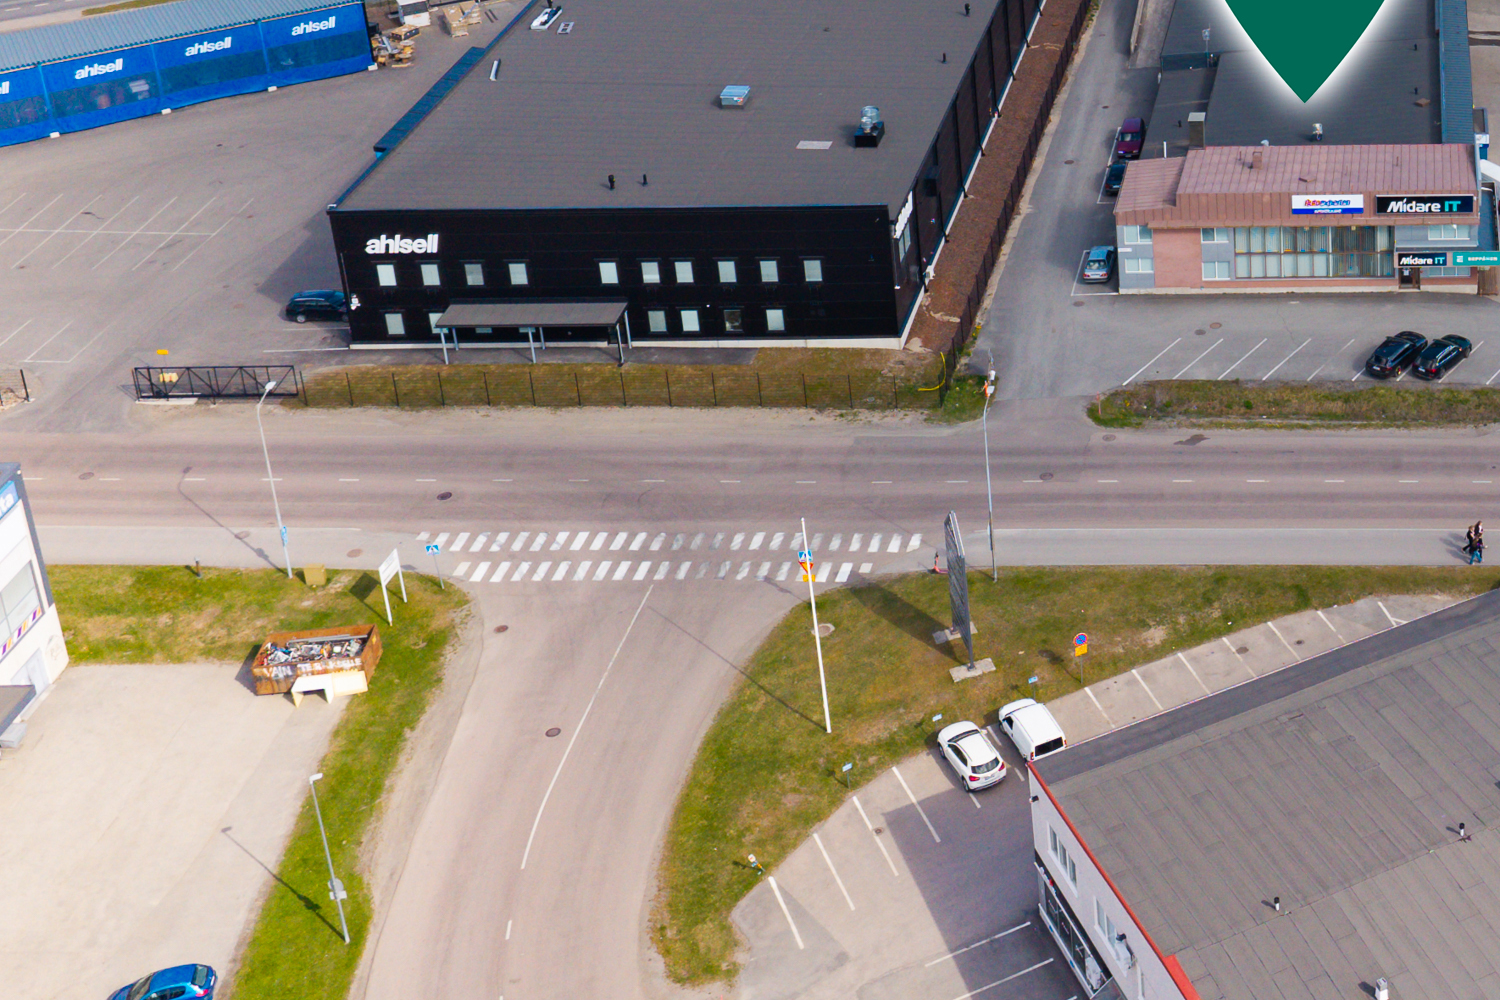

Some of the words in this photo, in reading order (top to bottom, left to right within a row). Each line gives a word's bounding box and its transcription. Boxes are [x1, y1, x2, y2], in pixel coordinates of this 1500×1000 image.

[292, 16, 336, 36] ahlsell
[185, 36, 232, 57] ahlsell
[75, 58, 123, 79] ahlsell
[1386, 197, 1441, 213] Midare
[1444, 200, 1461, 212] IT
[365, 233, 439, 255] ahlsell
[1400, 255, 1433, 265] Midare
[1434, 256, 1446, 265] IT
